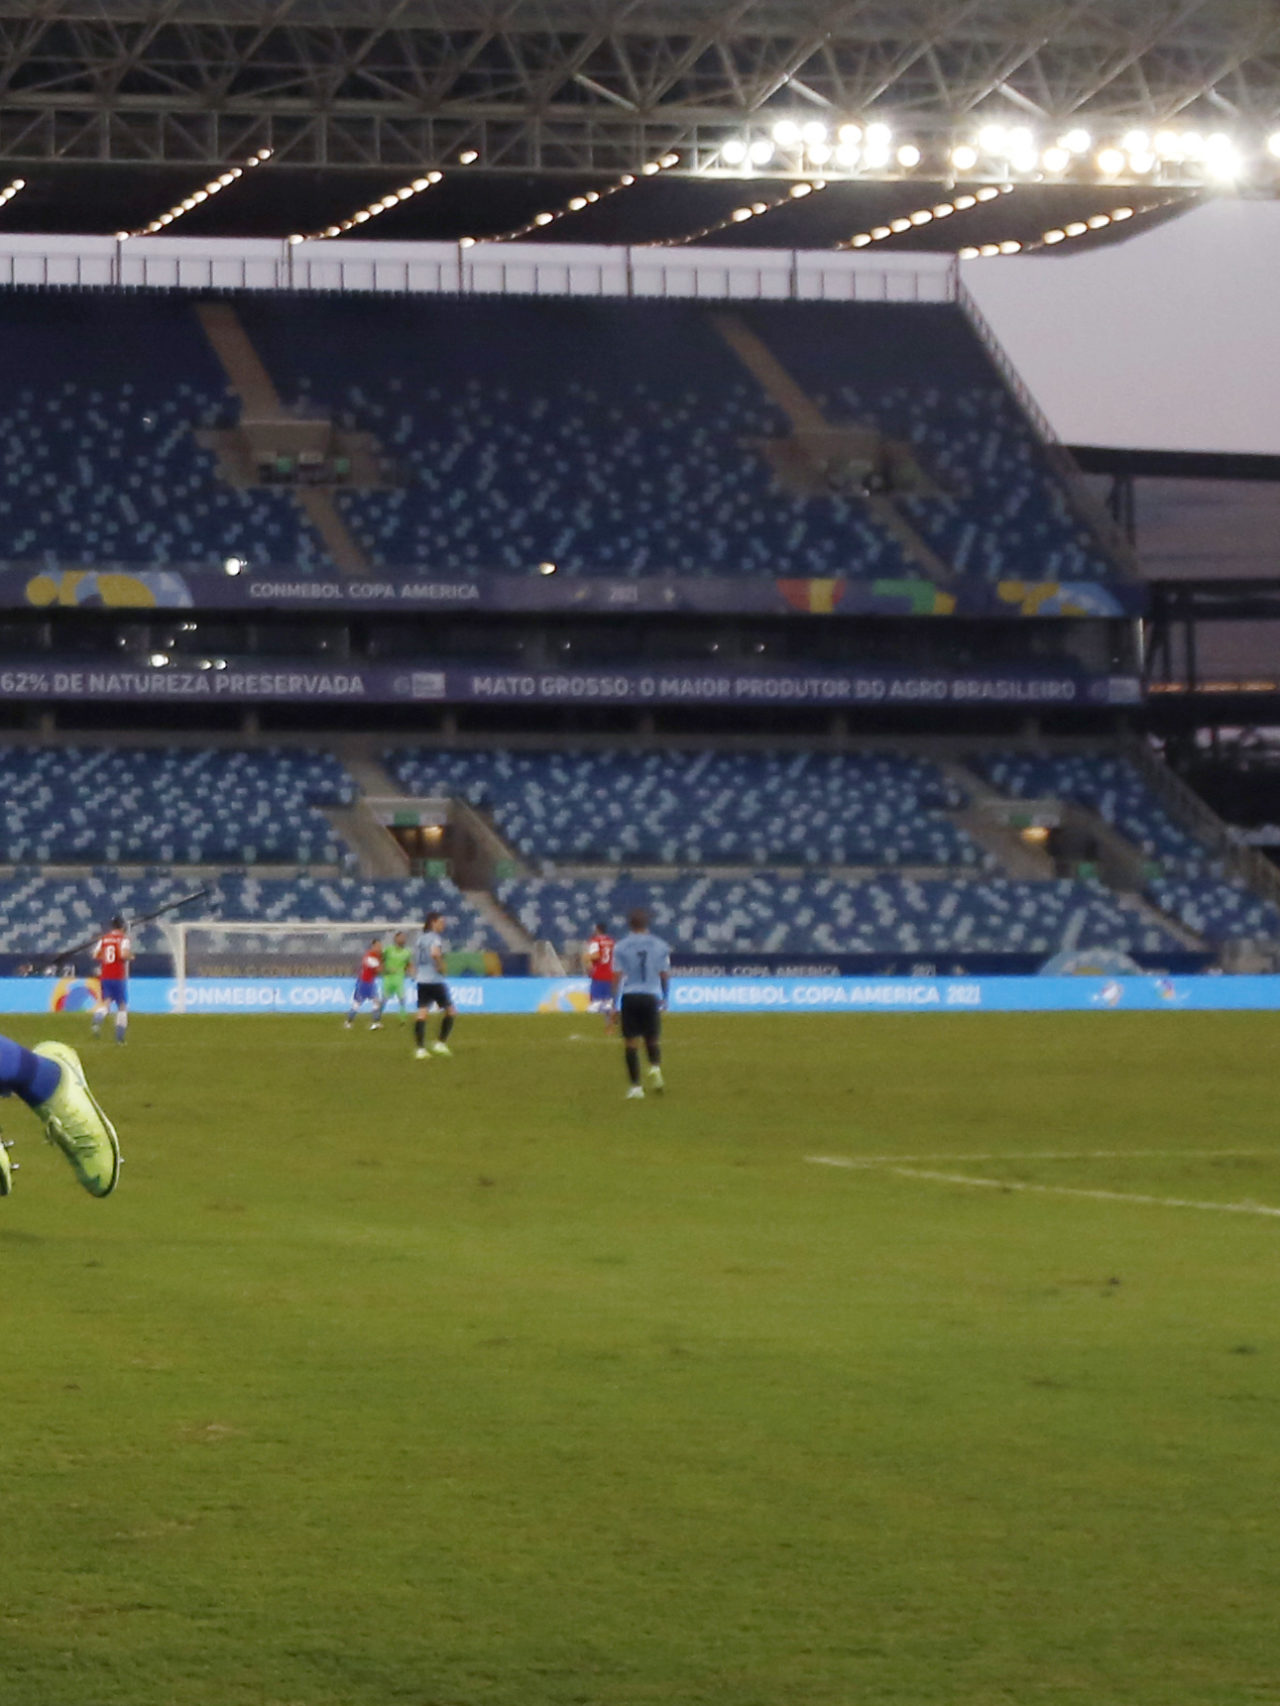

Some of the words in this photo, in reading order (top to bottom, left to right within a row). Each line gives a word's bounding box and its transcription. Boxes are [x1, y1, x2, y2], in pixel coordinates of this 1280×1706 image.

[250, 583, 344, 599] CONMEBOL
[349, 583, 396, 599] COPA
[401, 583, 480, 600] AMERICA
[0, 672, 48, 692] 62%
[54, 673, 83, 692] DE
[89, 673, 211, 693] NATUREZA
[216, 674, 364, 694] PRESERVADA
[473, 676, 535, 696] MATO
[541, 677, 636, 696] GROSSO:
[641, 677, 655, 696] O
[660, 678, 729, 697] MAIOR
[736, 679, 850, 698] PRODUTOR
[856, 679, 886, 698] DO
[891, 680, 947, 699] AGRO
[953, 681, 1075, 699] BRASILEIRO
[169, 986, 284, 1005] CONMEBOL
[290, 986, 346, 1005] COPA
[676, 986, 789, 1004] CONMEBOL
[792, 986, 846, 1004] COPA
[851, 986, 939, 1004] AMERICA
[948, 985, 980, 1004] 2021
